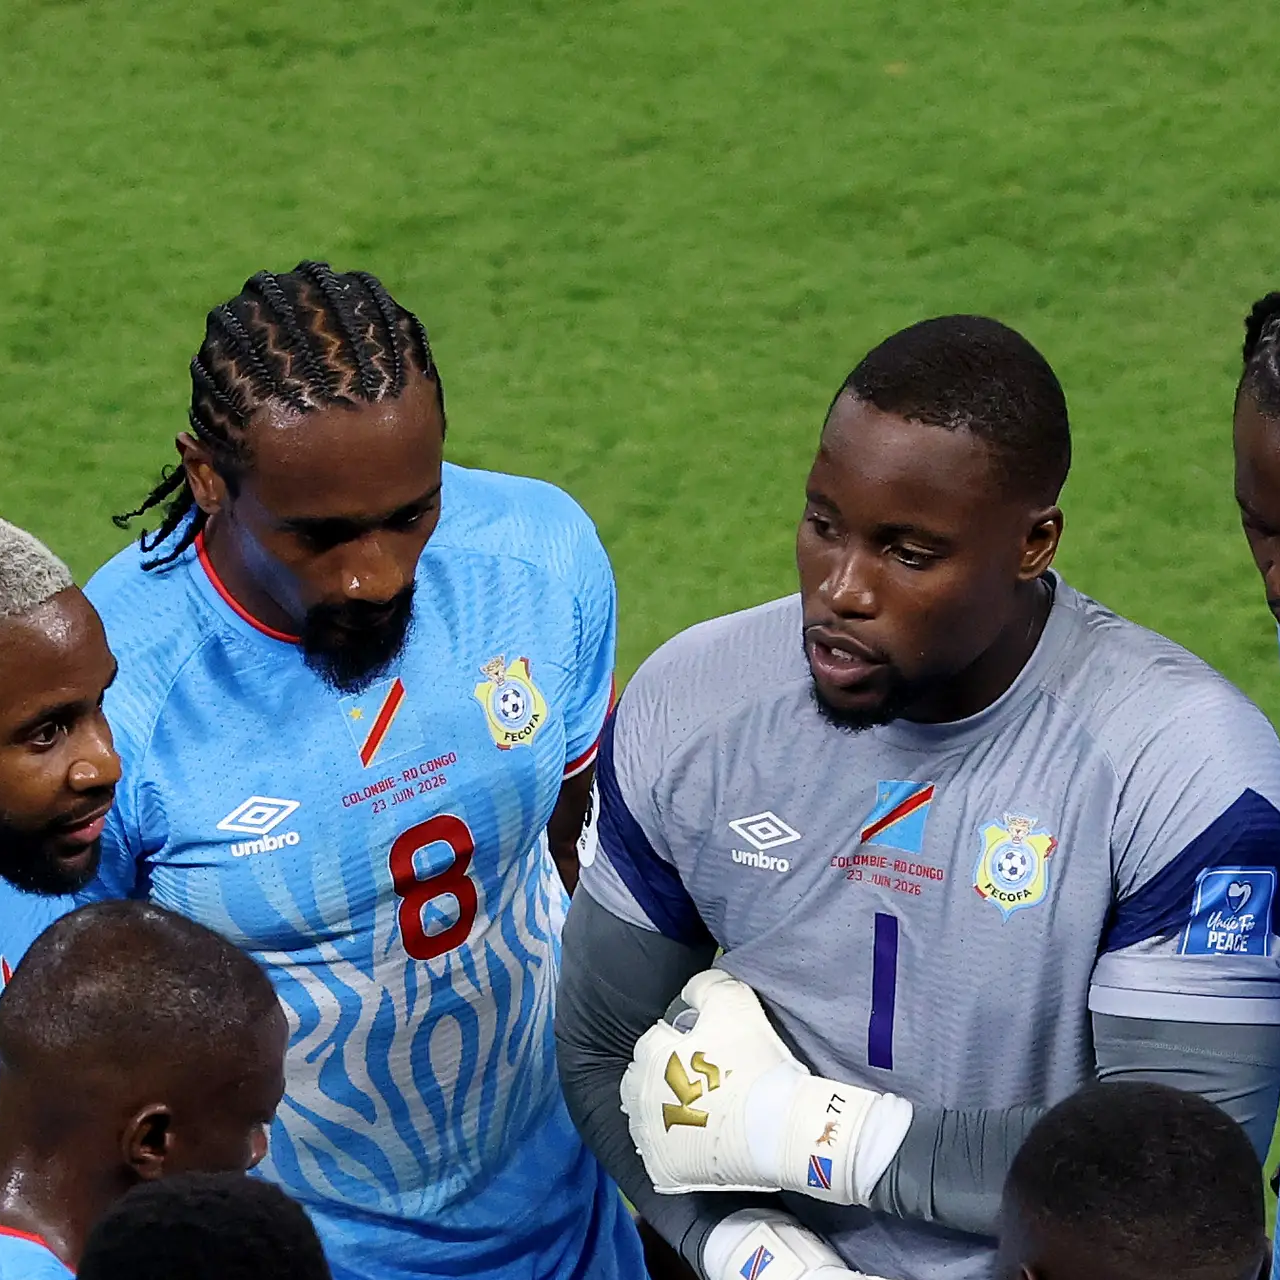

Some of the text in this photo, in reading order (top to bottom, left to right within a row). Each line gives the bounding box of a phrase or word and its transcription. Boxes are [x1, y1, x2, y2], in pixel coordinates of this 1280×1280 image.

[503, 712, 541, 743] FECOFA
[341, 776, 397, 808] COLOMBIE
[402, 766, 419, 783] RD
[419, 751, 457, 775] CONGO
[371, 773, 448, 814] 23 JUIN 2026
[230, 830, 300, 858] umbro
[731, 848, 790, 873] umbro
[830, 855, 887, 870] COLOMBIE
[894, 860, 908, 873] RD
[907, 863, 945, 881] CONGO
[387, 813, 478, 962] 8
[846, 869, 863, 882] 23
[894, 878, 922, 896] 2026
[984, 882, 1034, 903] FECOFA
[1207, 931, 1249, 952] PEACE
[867, 911, 899, 1071] 1
[826, 1092, 846, 1115] 77
